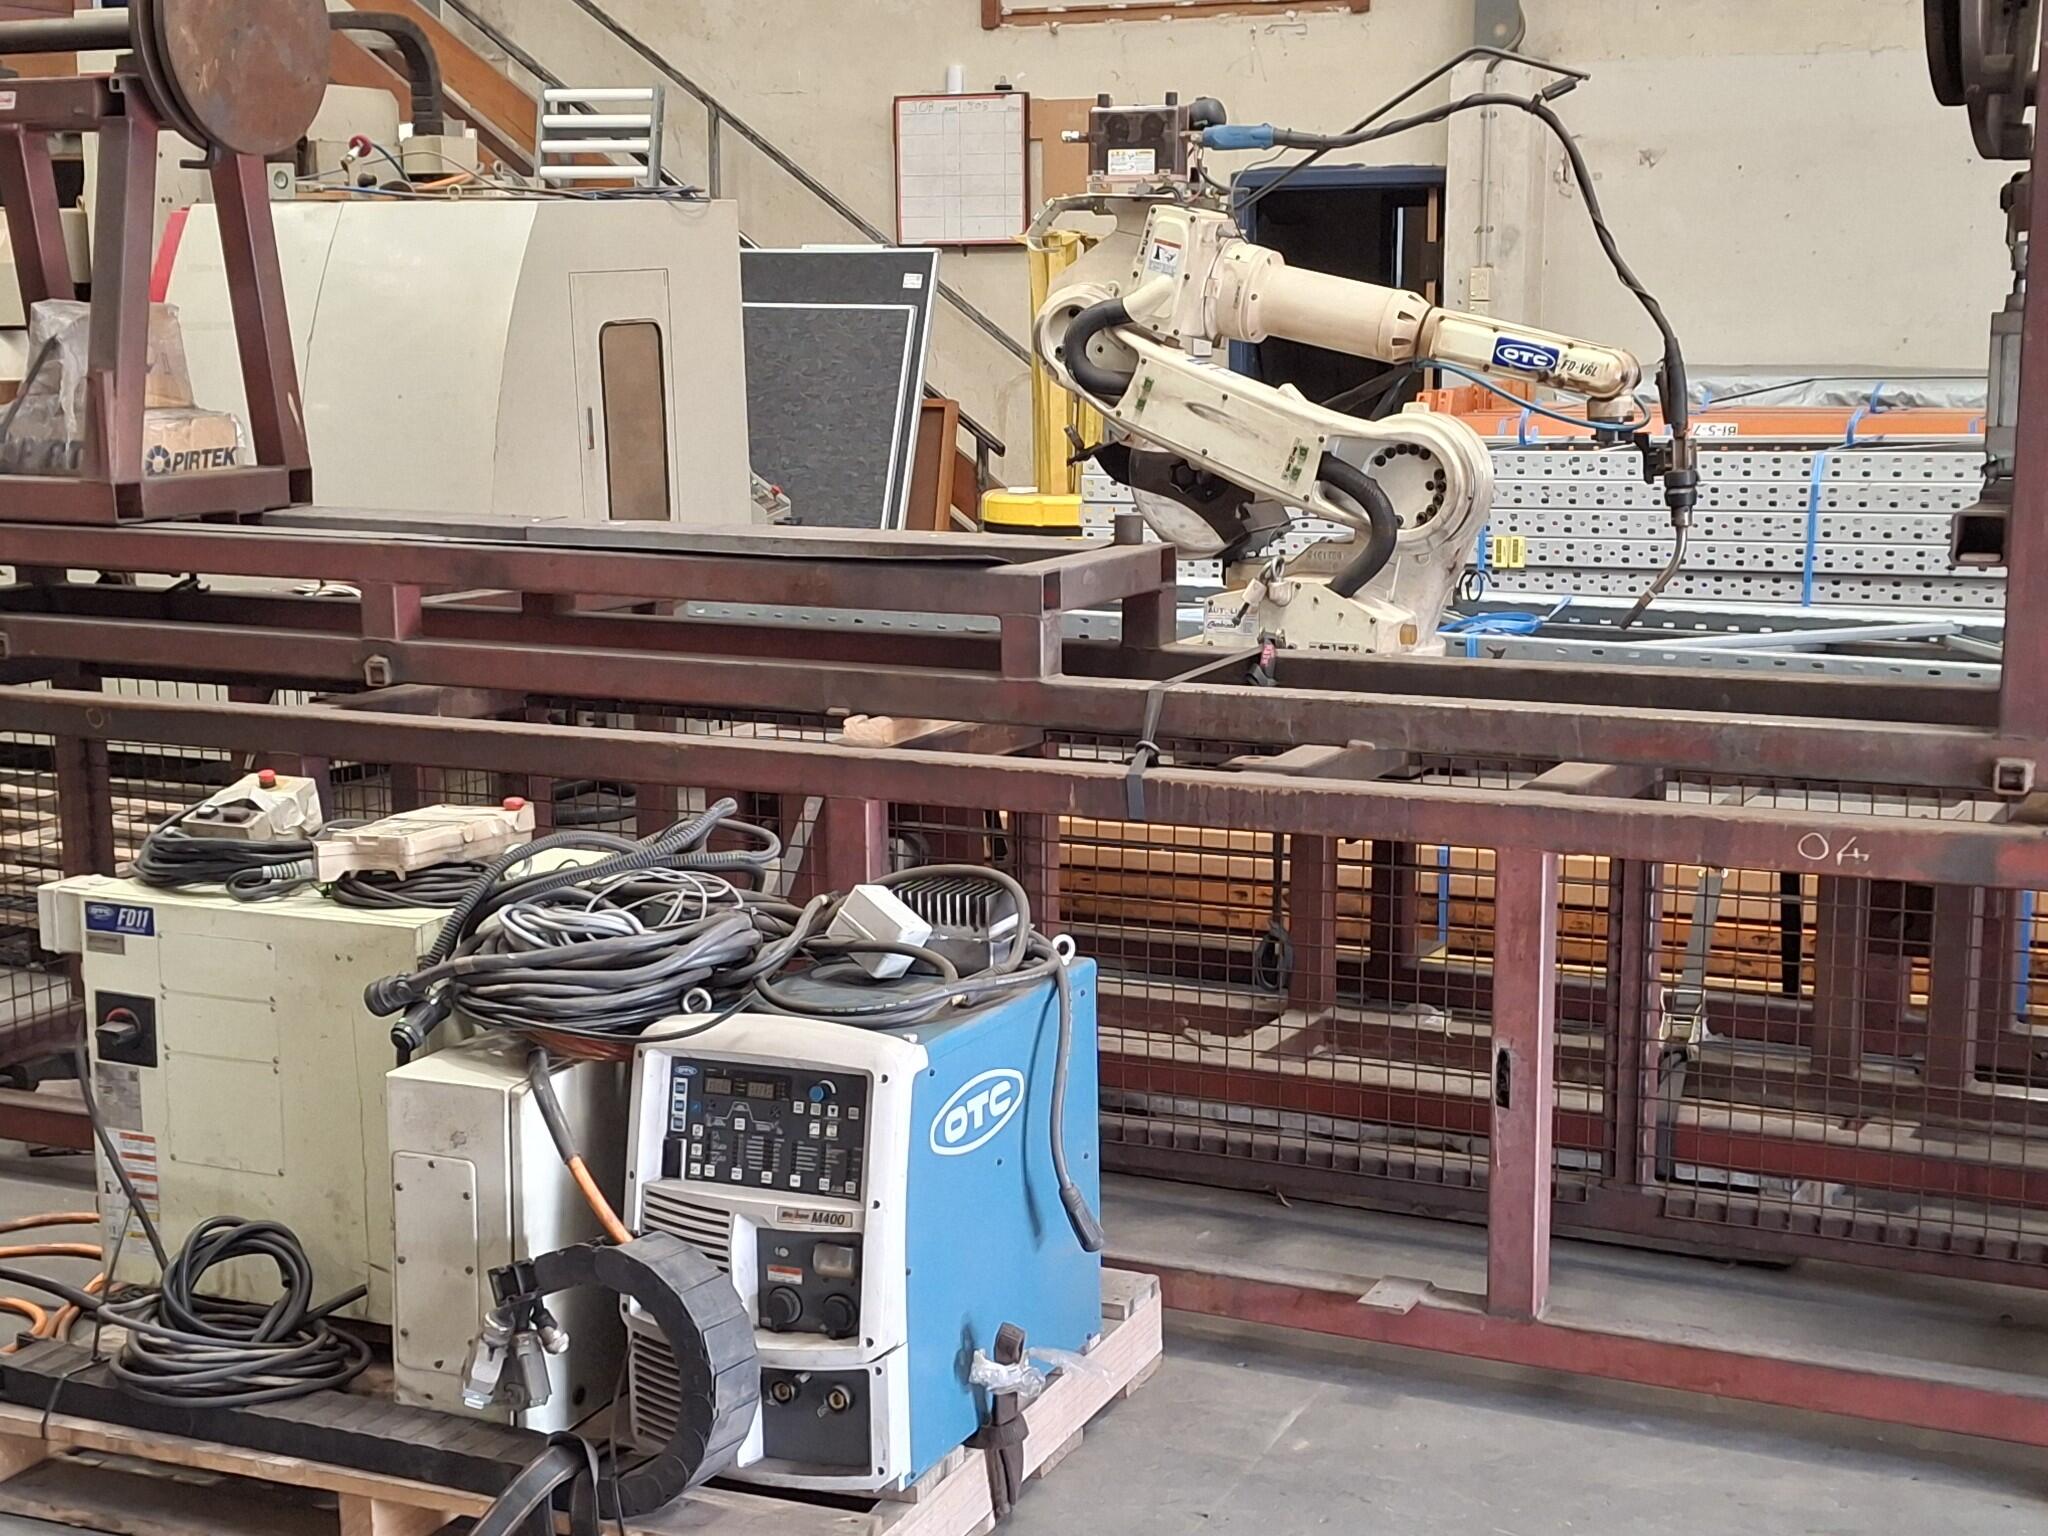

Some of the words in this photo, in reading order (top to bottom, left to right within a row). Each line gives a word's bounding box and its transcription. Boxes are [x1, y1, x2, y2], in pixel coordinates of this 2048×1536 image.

[1503, 347, 1549, 366] OTC
[1560, 359, 1599, 377] FD-V6L
[172, 447, 237, 472] PIRTEK
[117, 907, 150, 929] FD11
[944, 1080, 1012, 1144] OTC
[811, 1211, 846, 1226] M400
